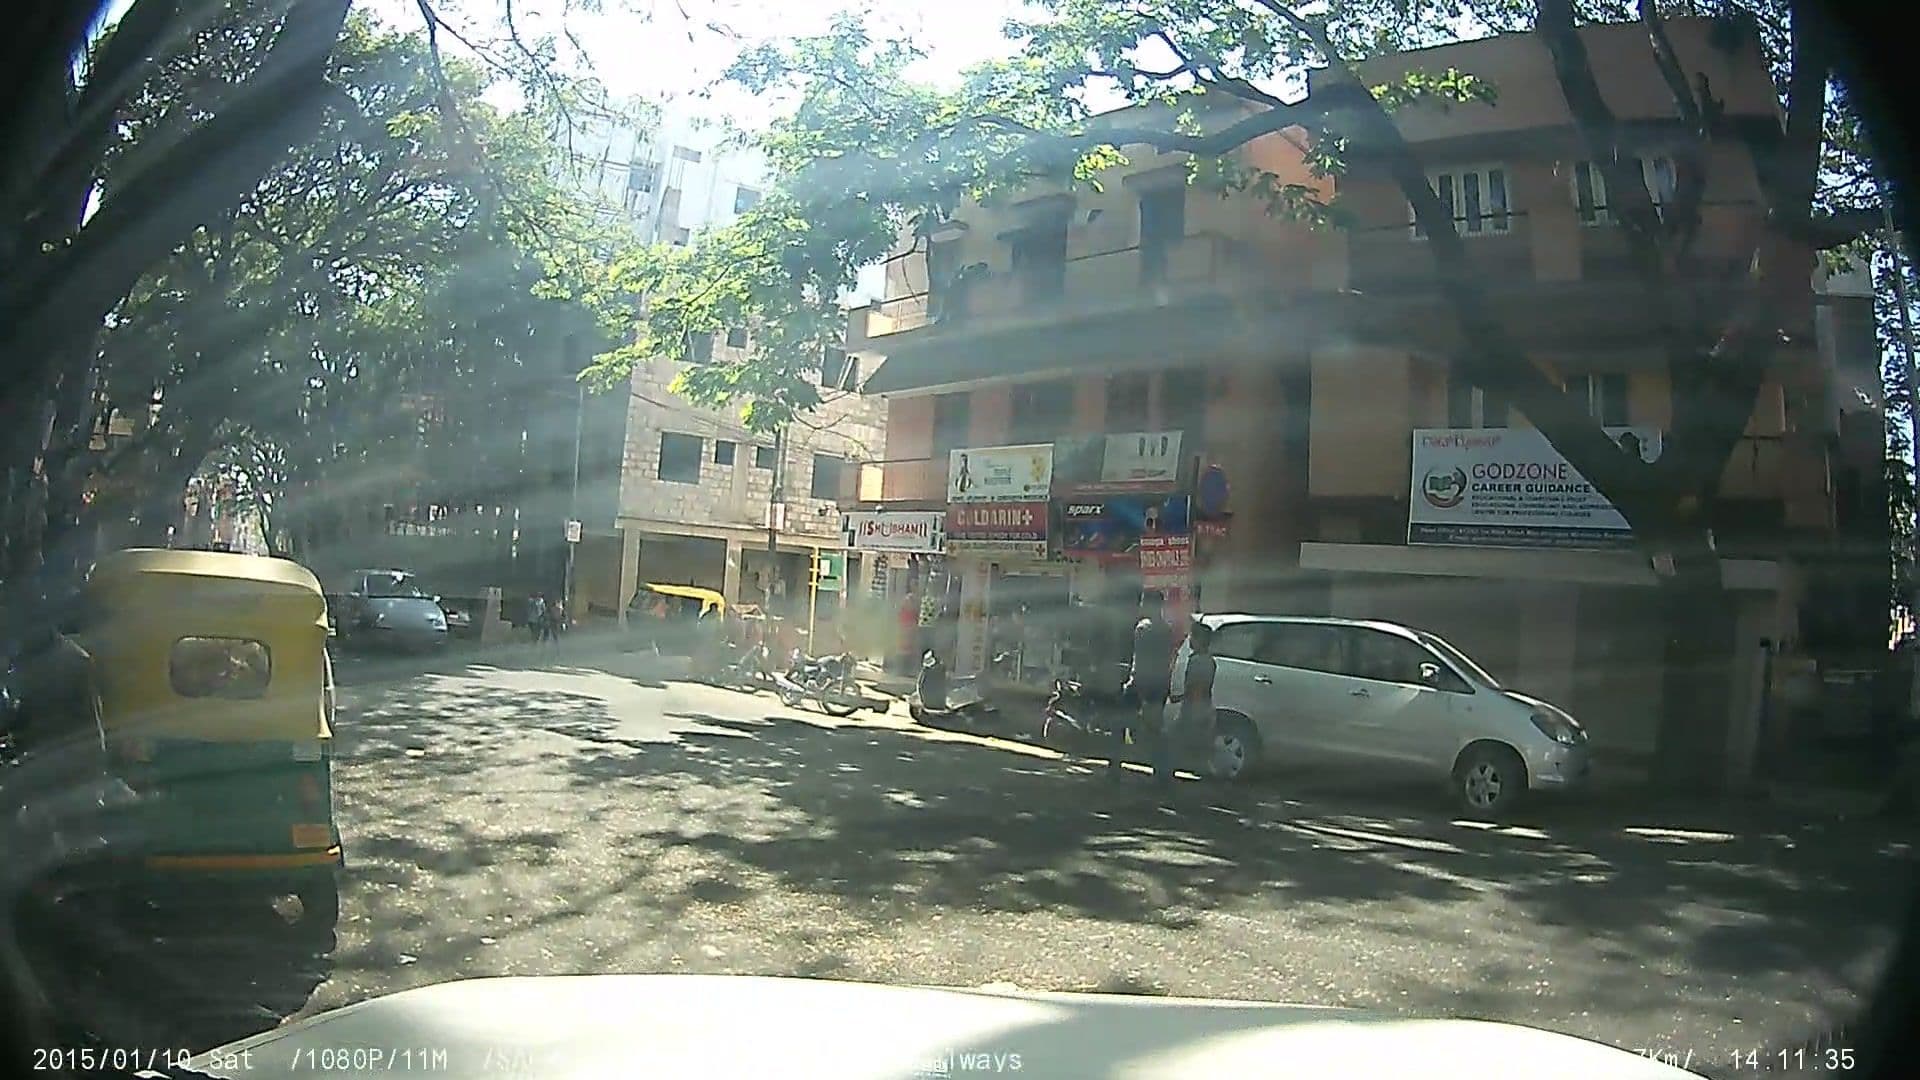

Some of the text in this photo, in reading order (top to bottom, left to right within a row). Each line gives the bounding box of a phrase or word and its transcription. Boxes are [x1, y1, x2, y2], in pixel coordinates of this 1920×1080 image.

[1472, 463, 1567, 480] GODZONE
[1472, 483, 1591, 494] CAREER GUIDANCE
[1067, 504, 1104, 517] sparx
